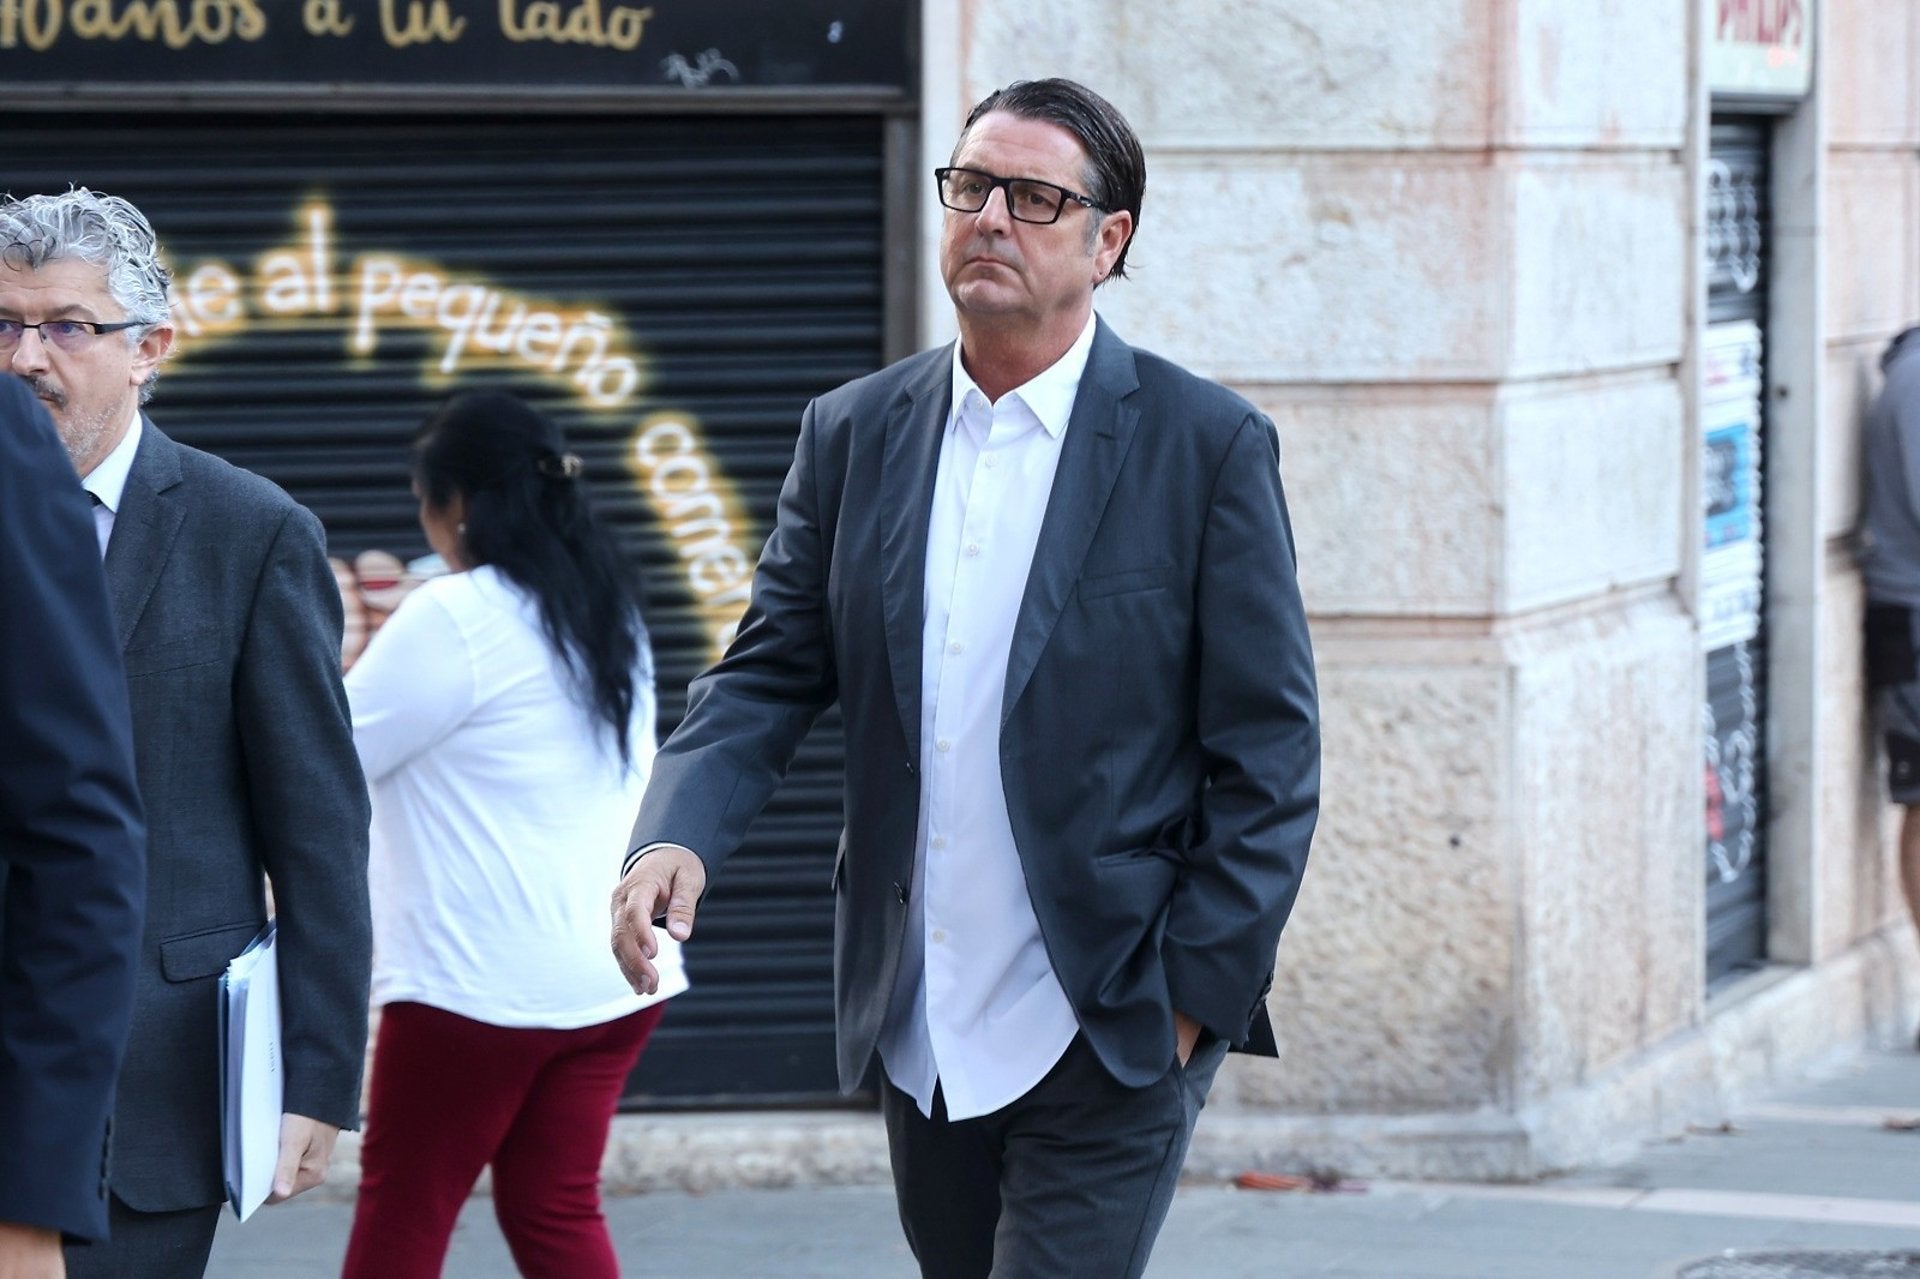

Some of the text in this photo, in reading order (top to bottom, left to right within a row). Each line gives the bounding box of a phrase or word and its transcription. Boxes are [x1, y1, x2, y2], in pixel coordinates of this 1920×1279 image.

[303, 0, 354, 36] a
[498, 0, 653, 49] lado
[261, 206, 334, 313] al
[354, 257, 640, 406] pequeño
